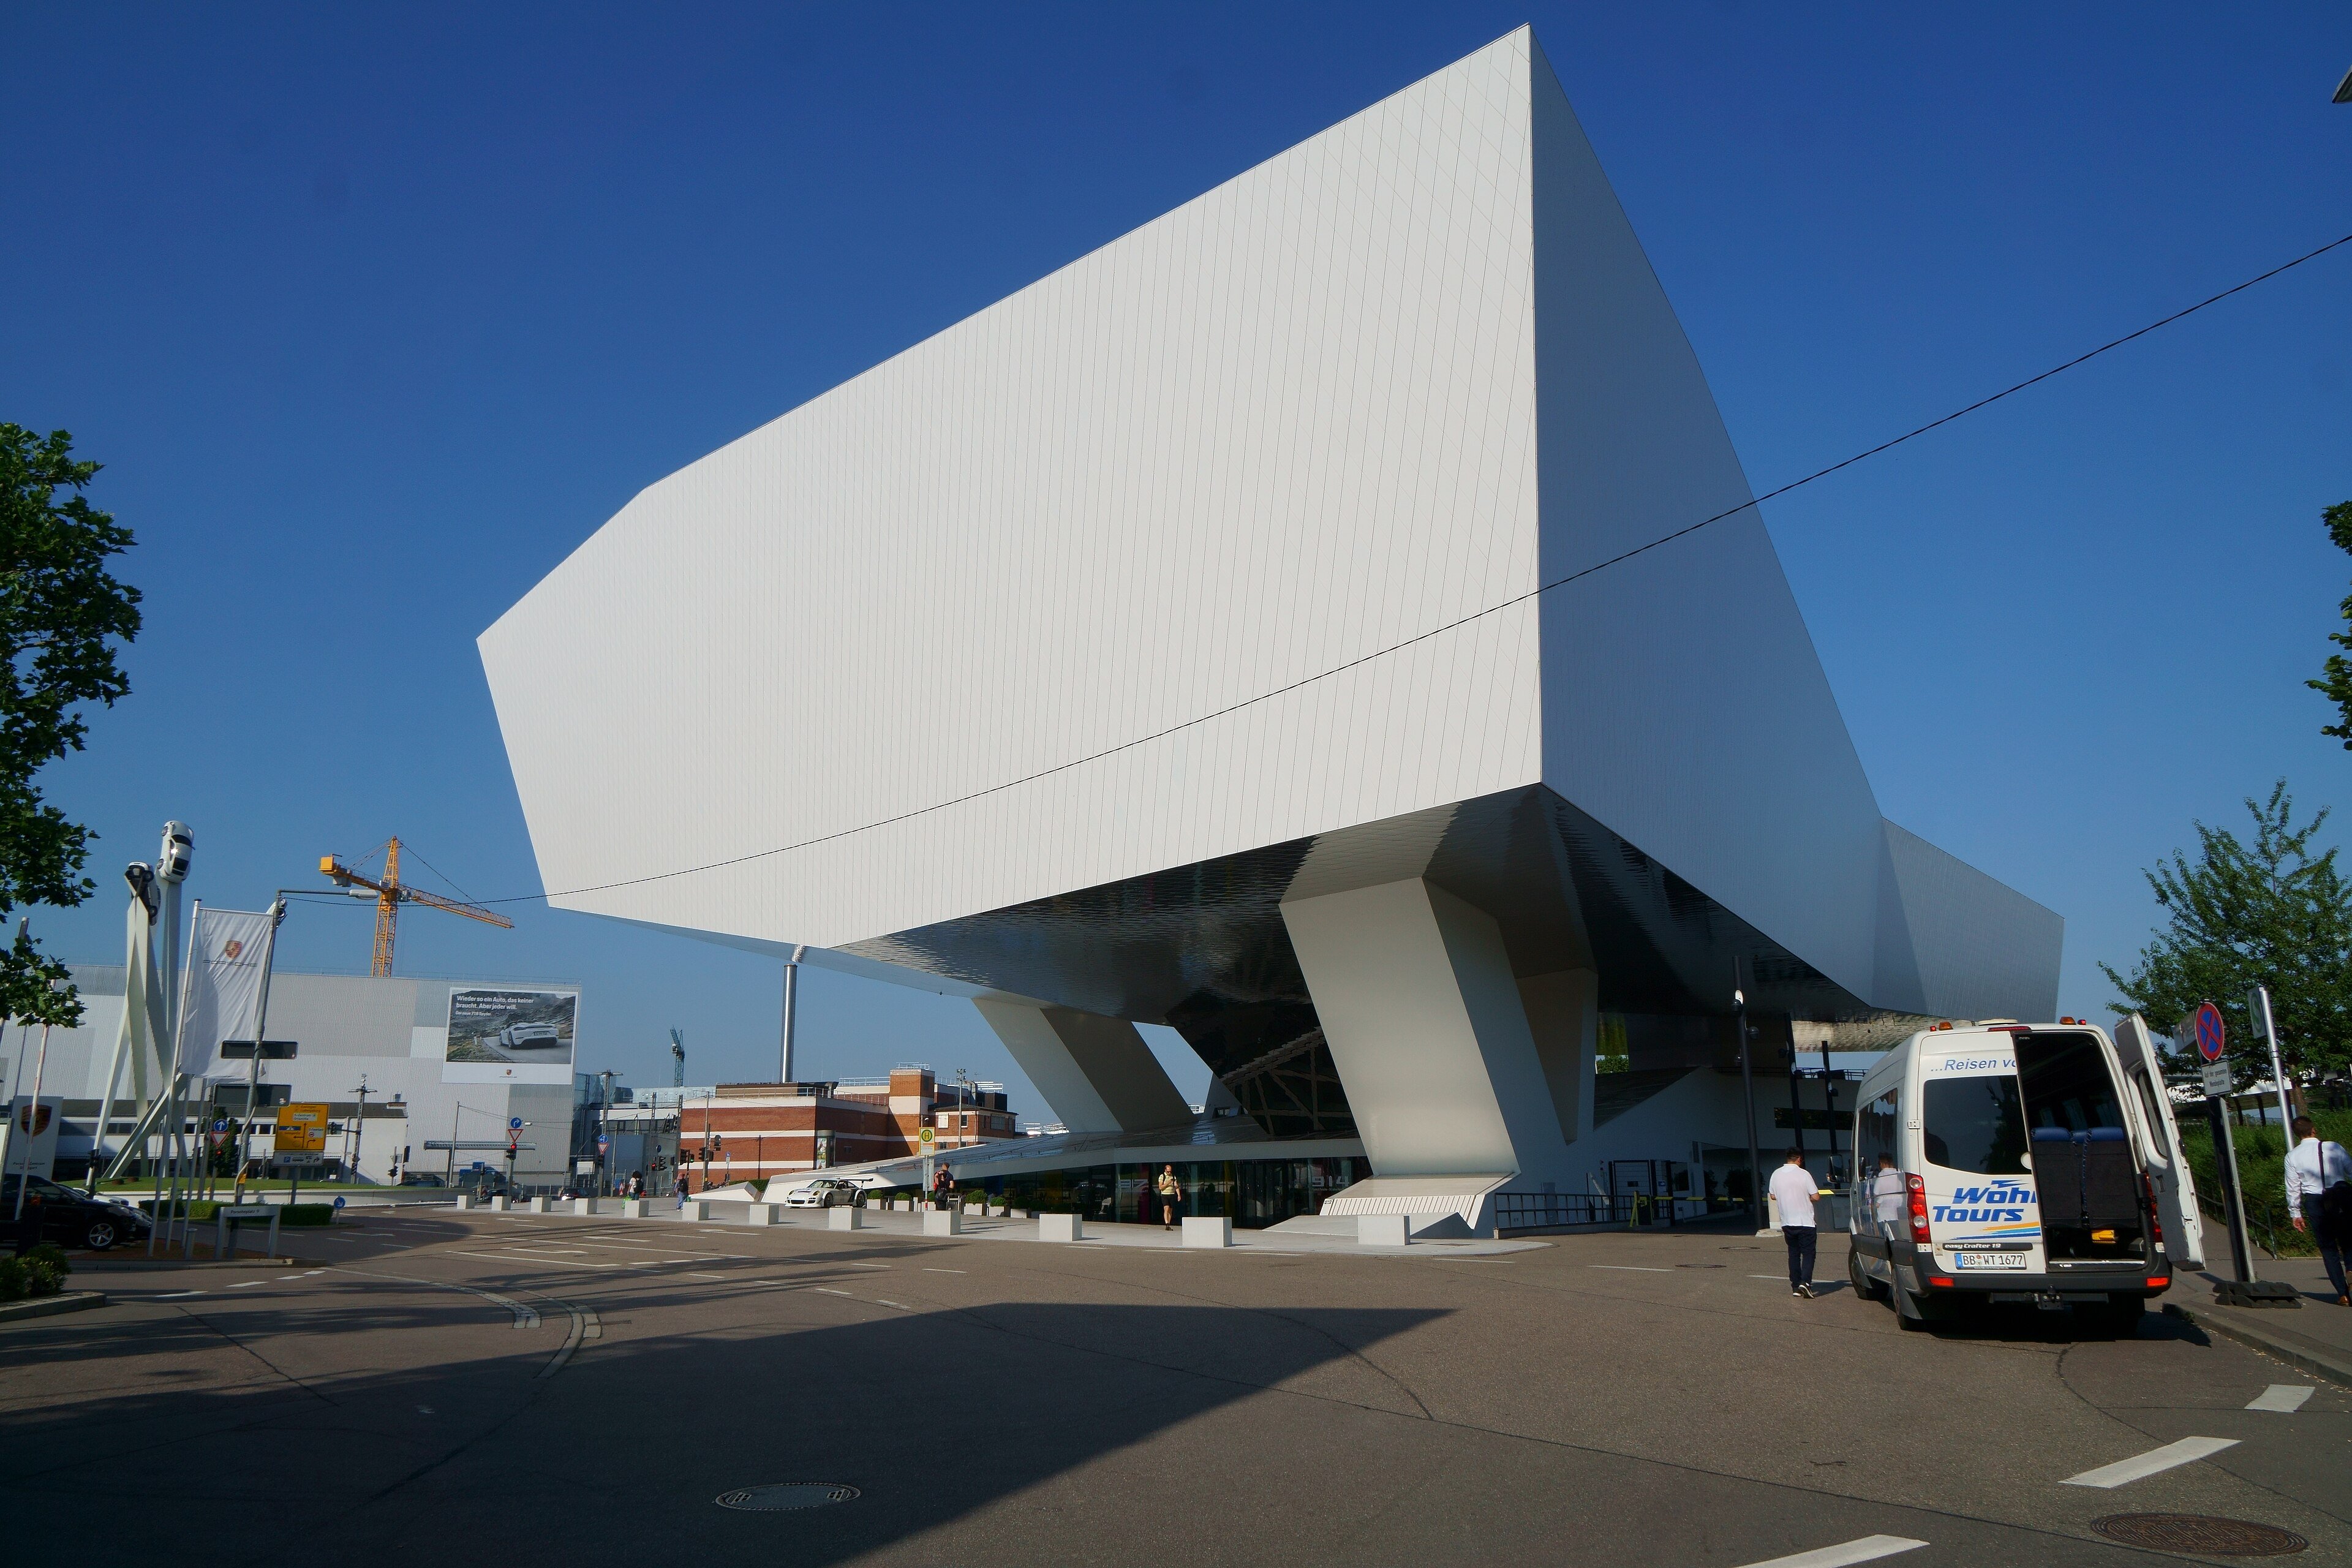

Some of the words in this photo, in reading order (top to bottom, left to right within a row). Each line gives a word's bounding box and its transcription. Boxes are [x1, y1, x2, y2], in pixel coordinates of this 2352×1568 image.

[1312, 1176, 1349, 1186] 914
[1932, 1205, 2024, 1222] Tours
[1962, 1255, 1976, 1265] BB
[1983, 1255, 1996, 1265] WT
[1998, 1255, 2022, 1265] 1677
